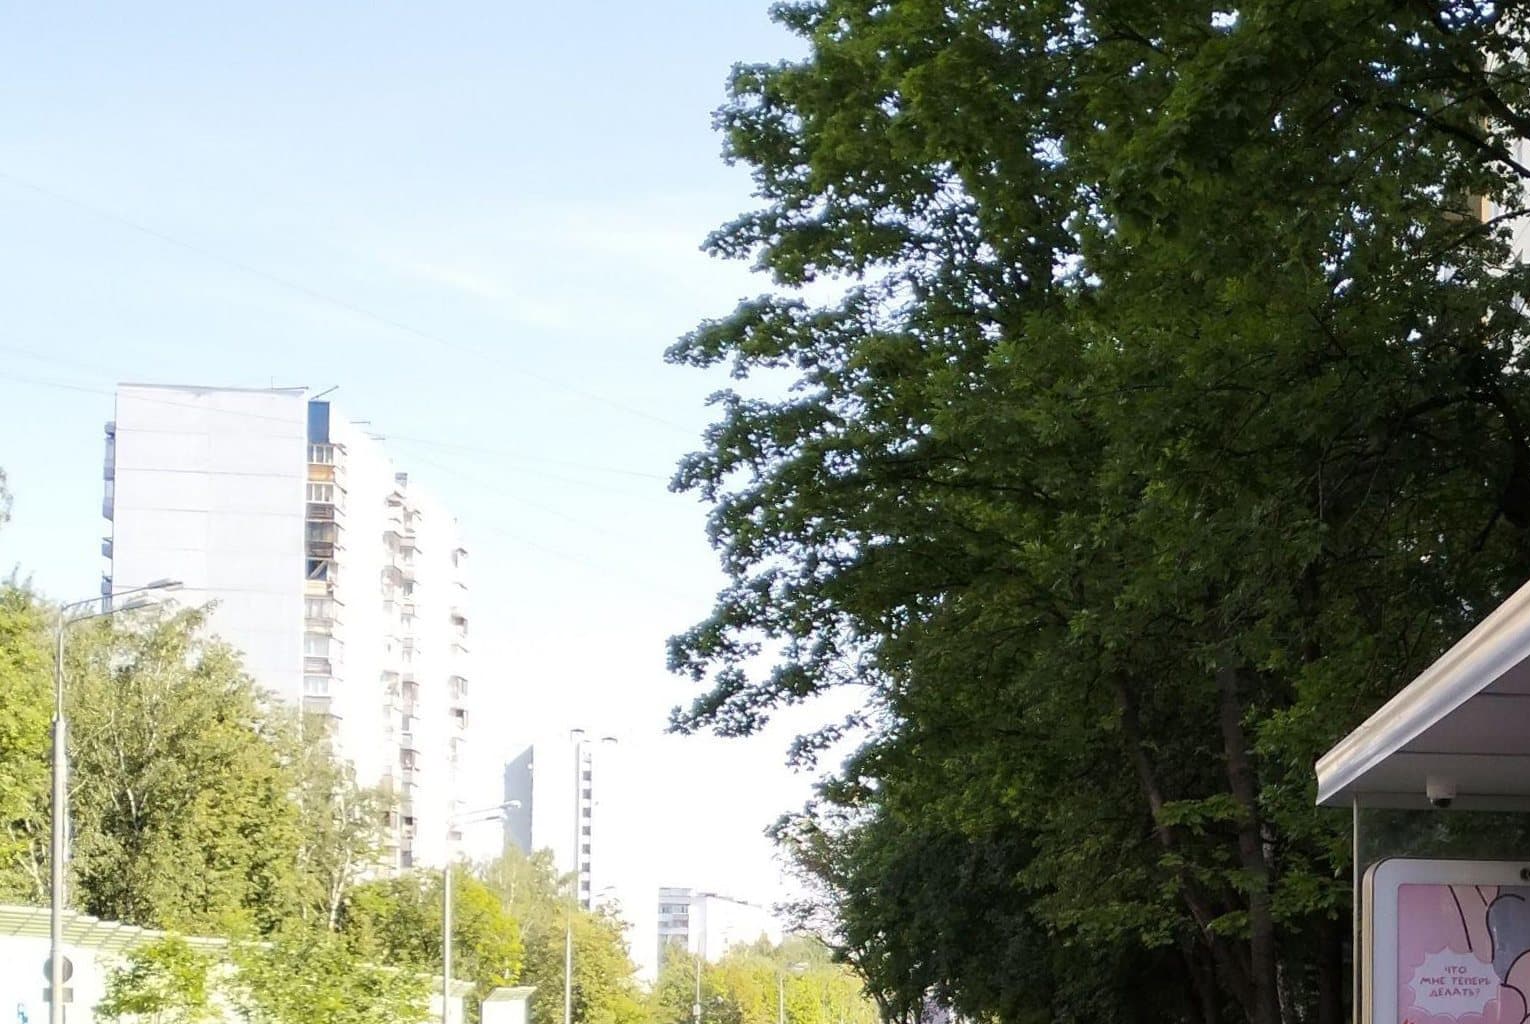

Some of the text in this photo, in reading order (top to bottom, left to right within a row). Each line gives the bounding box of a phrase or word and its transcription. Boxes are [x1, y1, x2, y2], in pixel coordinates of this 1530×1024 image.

[1444, 966, 1468, 975] ЧТО
[1419, 976, 1492, 986] МНЕ ТЕПЕРЬ
[1429, 987, 1481, 998] ДЕЛАТЬ?
